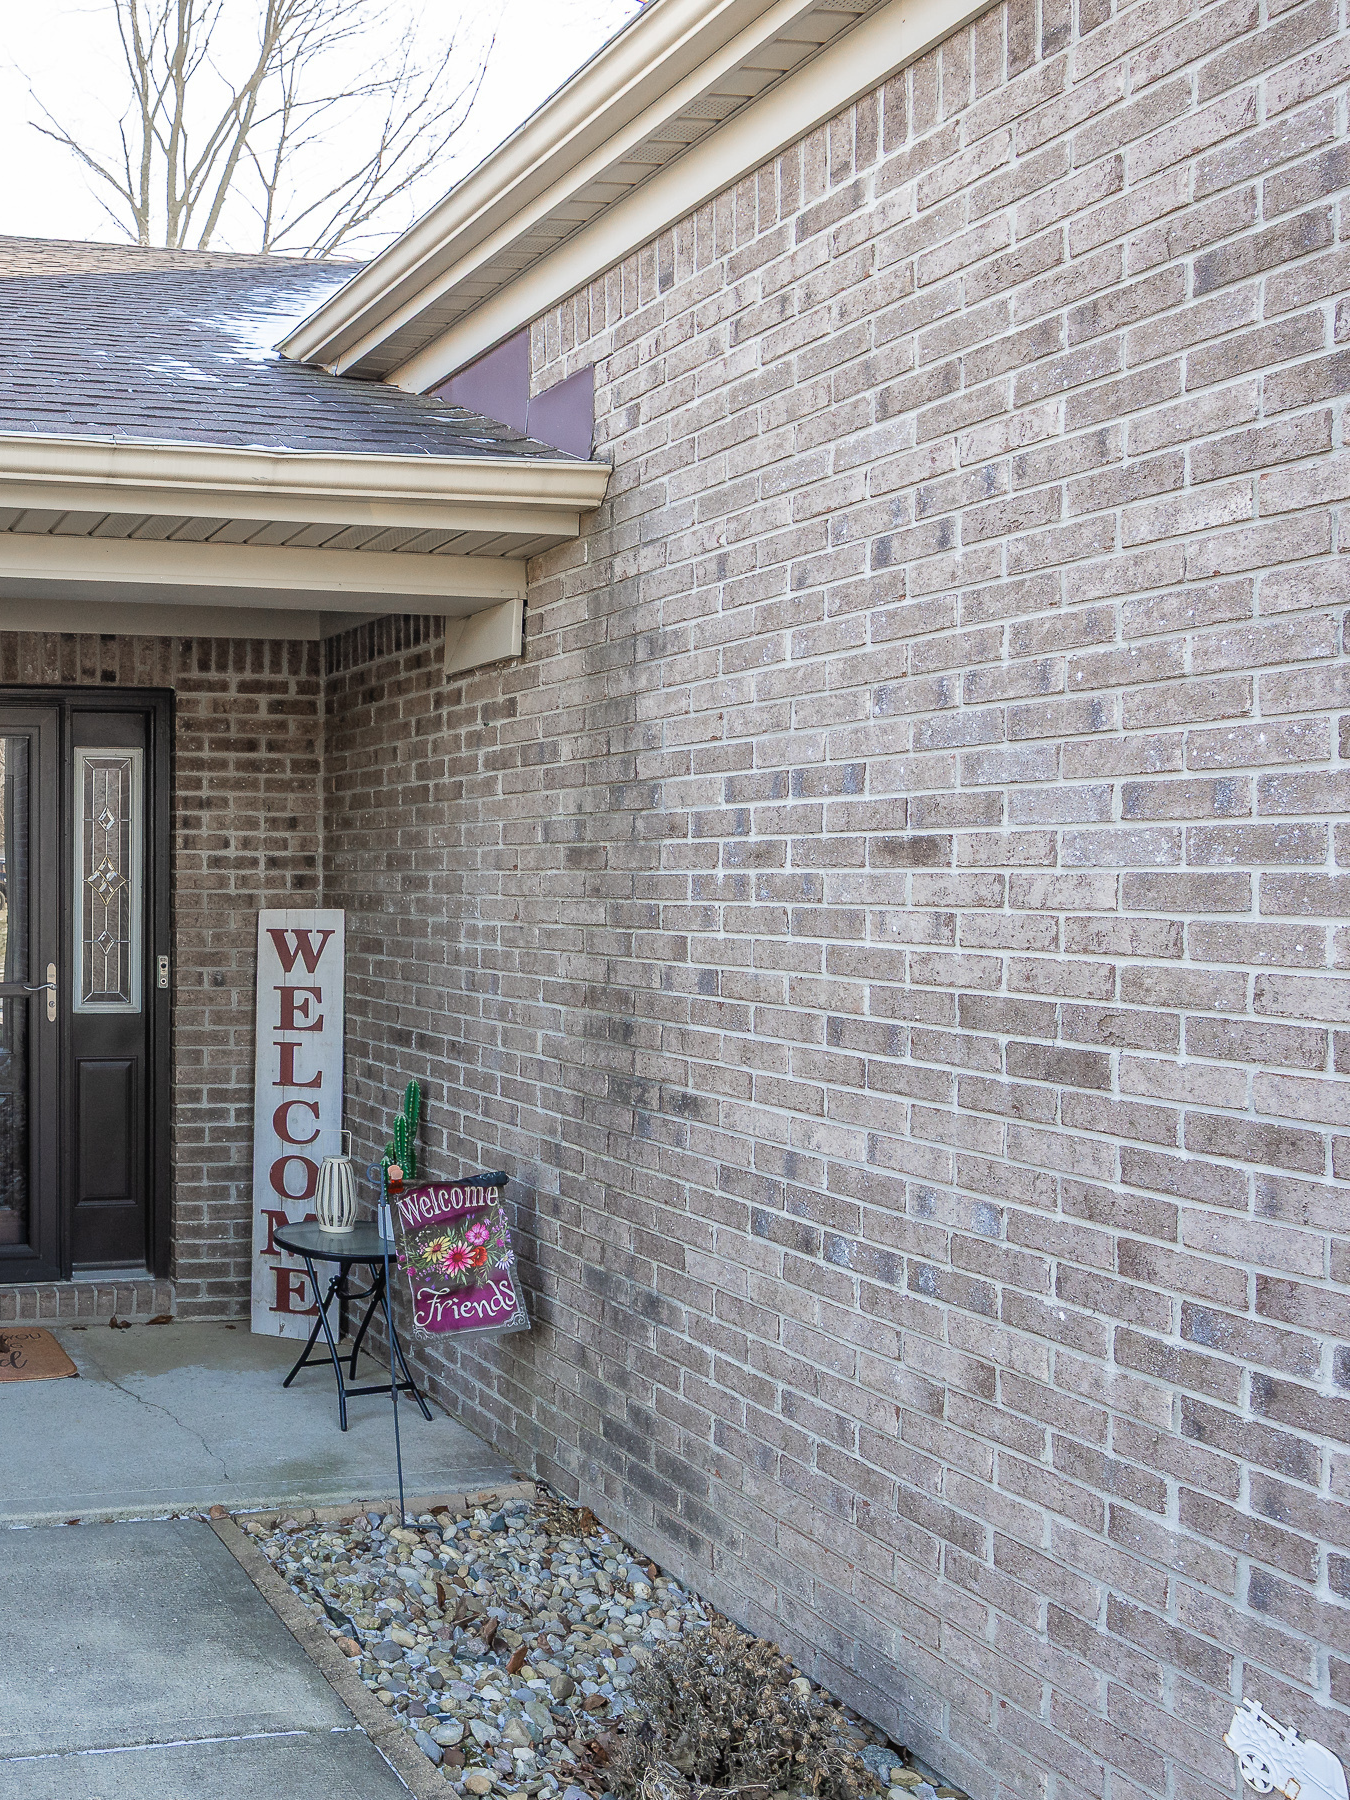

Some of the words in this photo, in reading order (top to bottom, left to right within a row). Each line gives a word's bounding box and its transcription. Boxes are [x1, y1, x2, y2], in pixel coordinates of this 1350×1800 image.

[396, 1185, 500, 1227] Welcome
[413, 1279, 517, 1328] Friends
[4, 1332, 42, 1341] YOU
